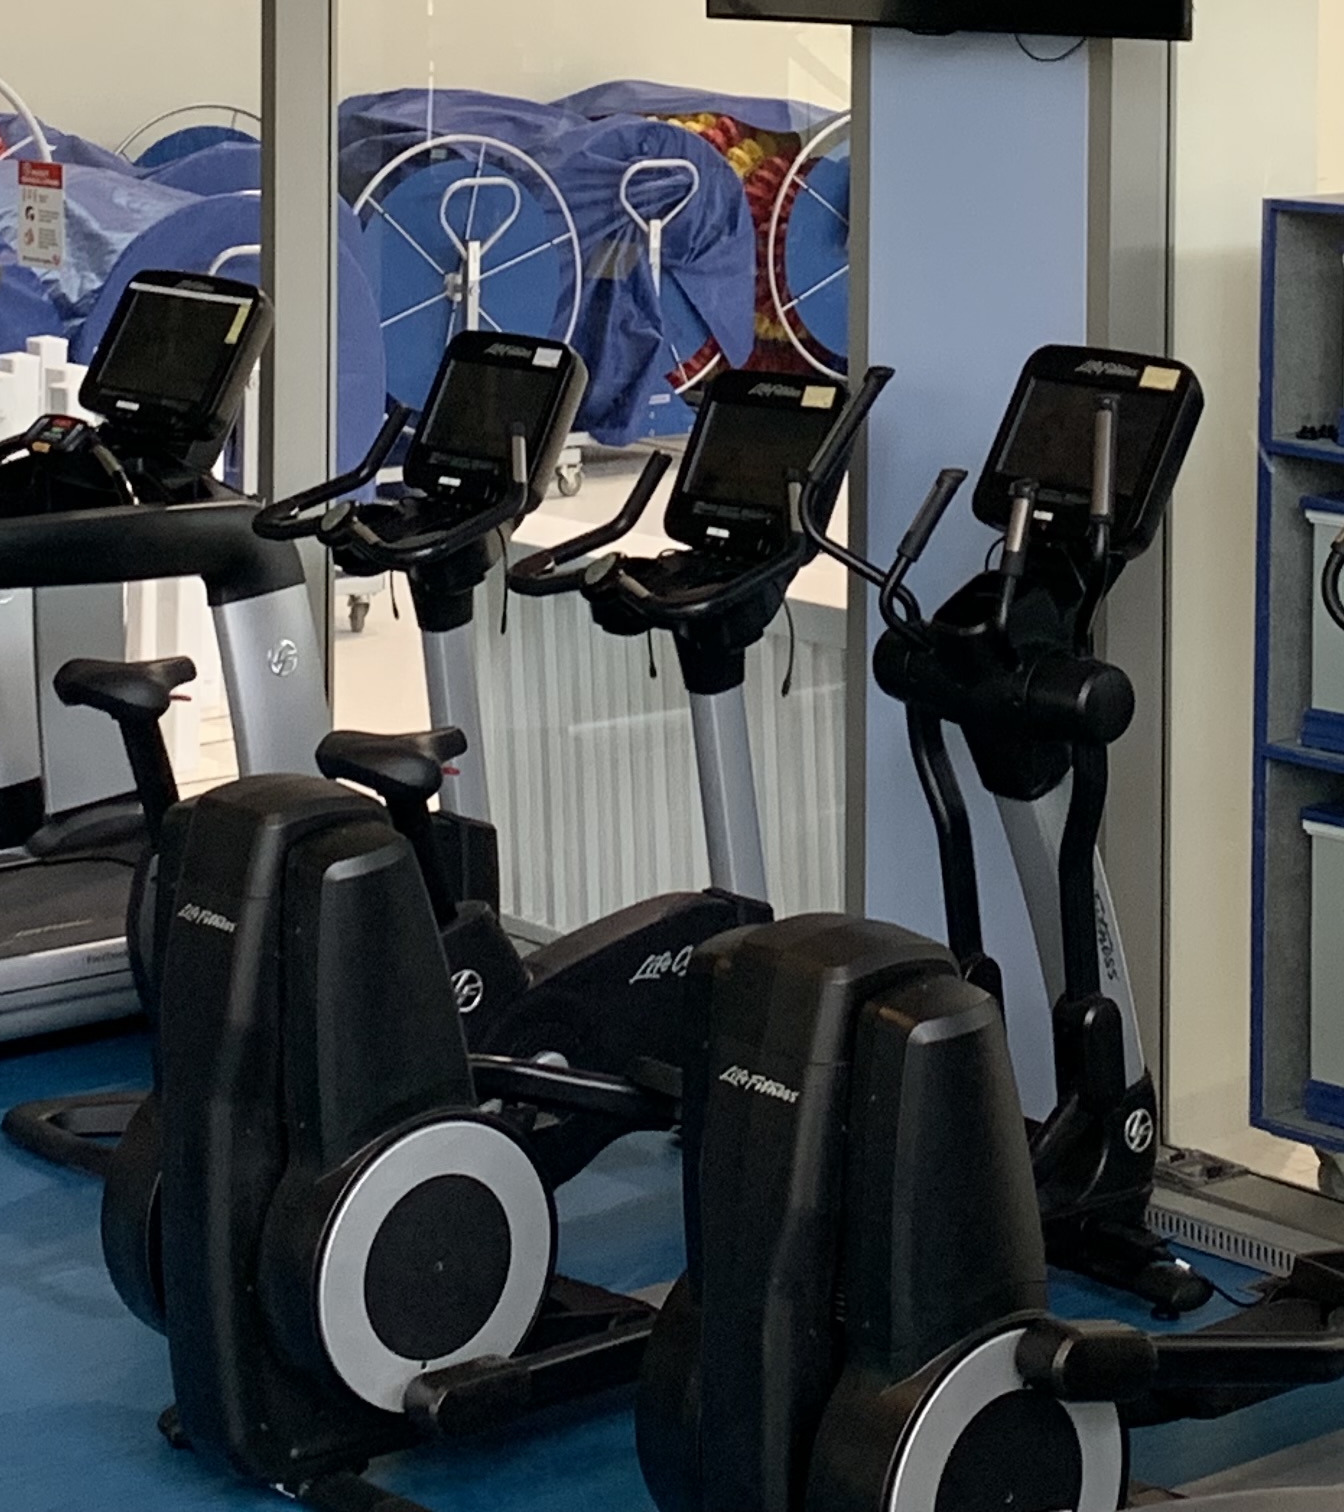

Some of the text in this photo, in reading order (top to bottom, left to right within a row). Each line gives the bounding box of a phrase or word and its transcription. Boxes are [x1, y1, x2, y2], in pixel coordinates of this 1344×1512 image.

[628, 952, 673, 985] Life
[719, 1065, 801, 1104] Life Fitness
